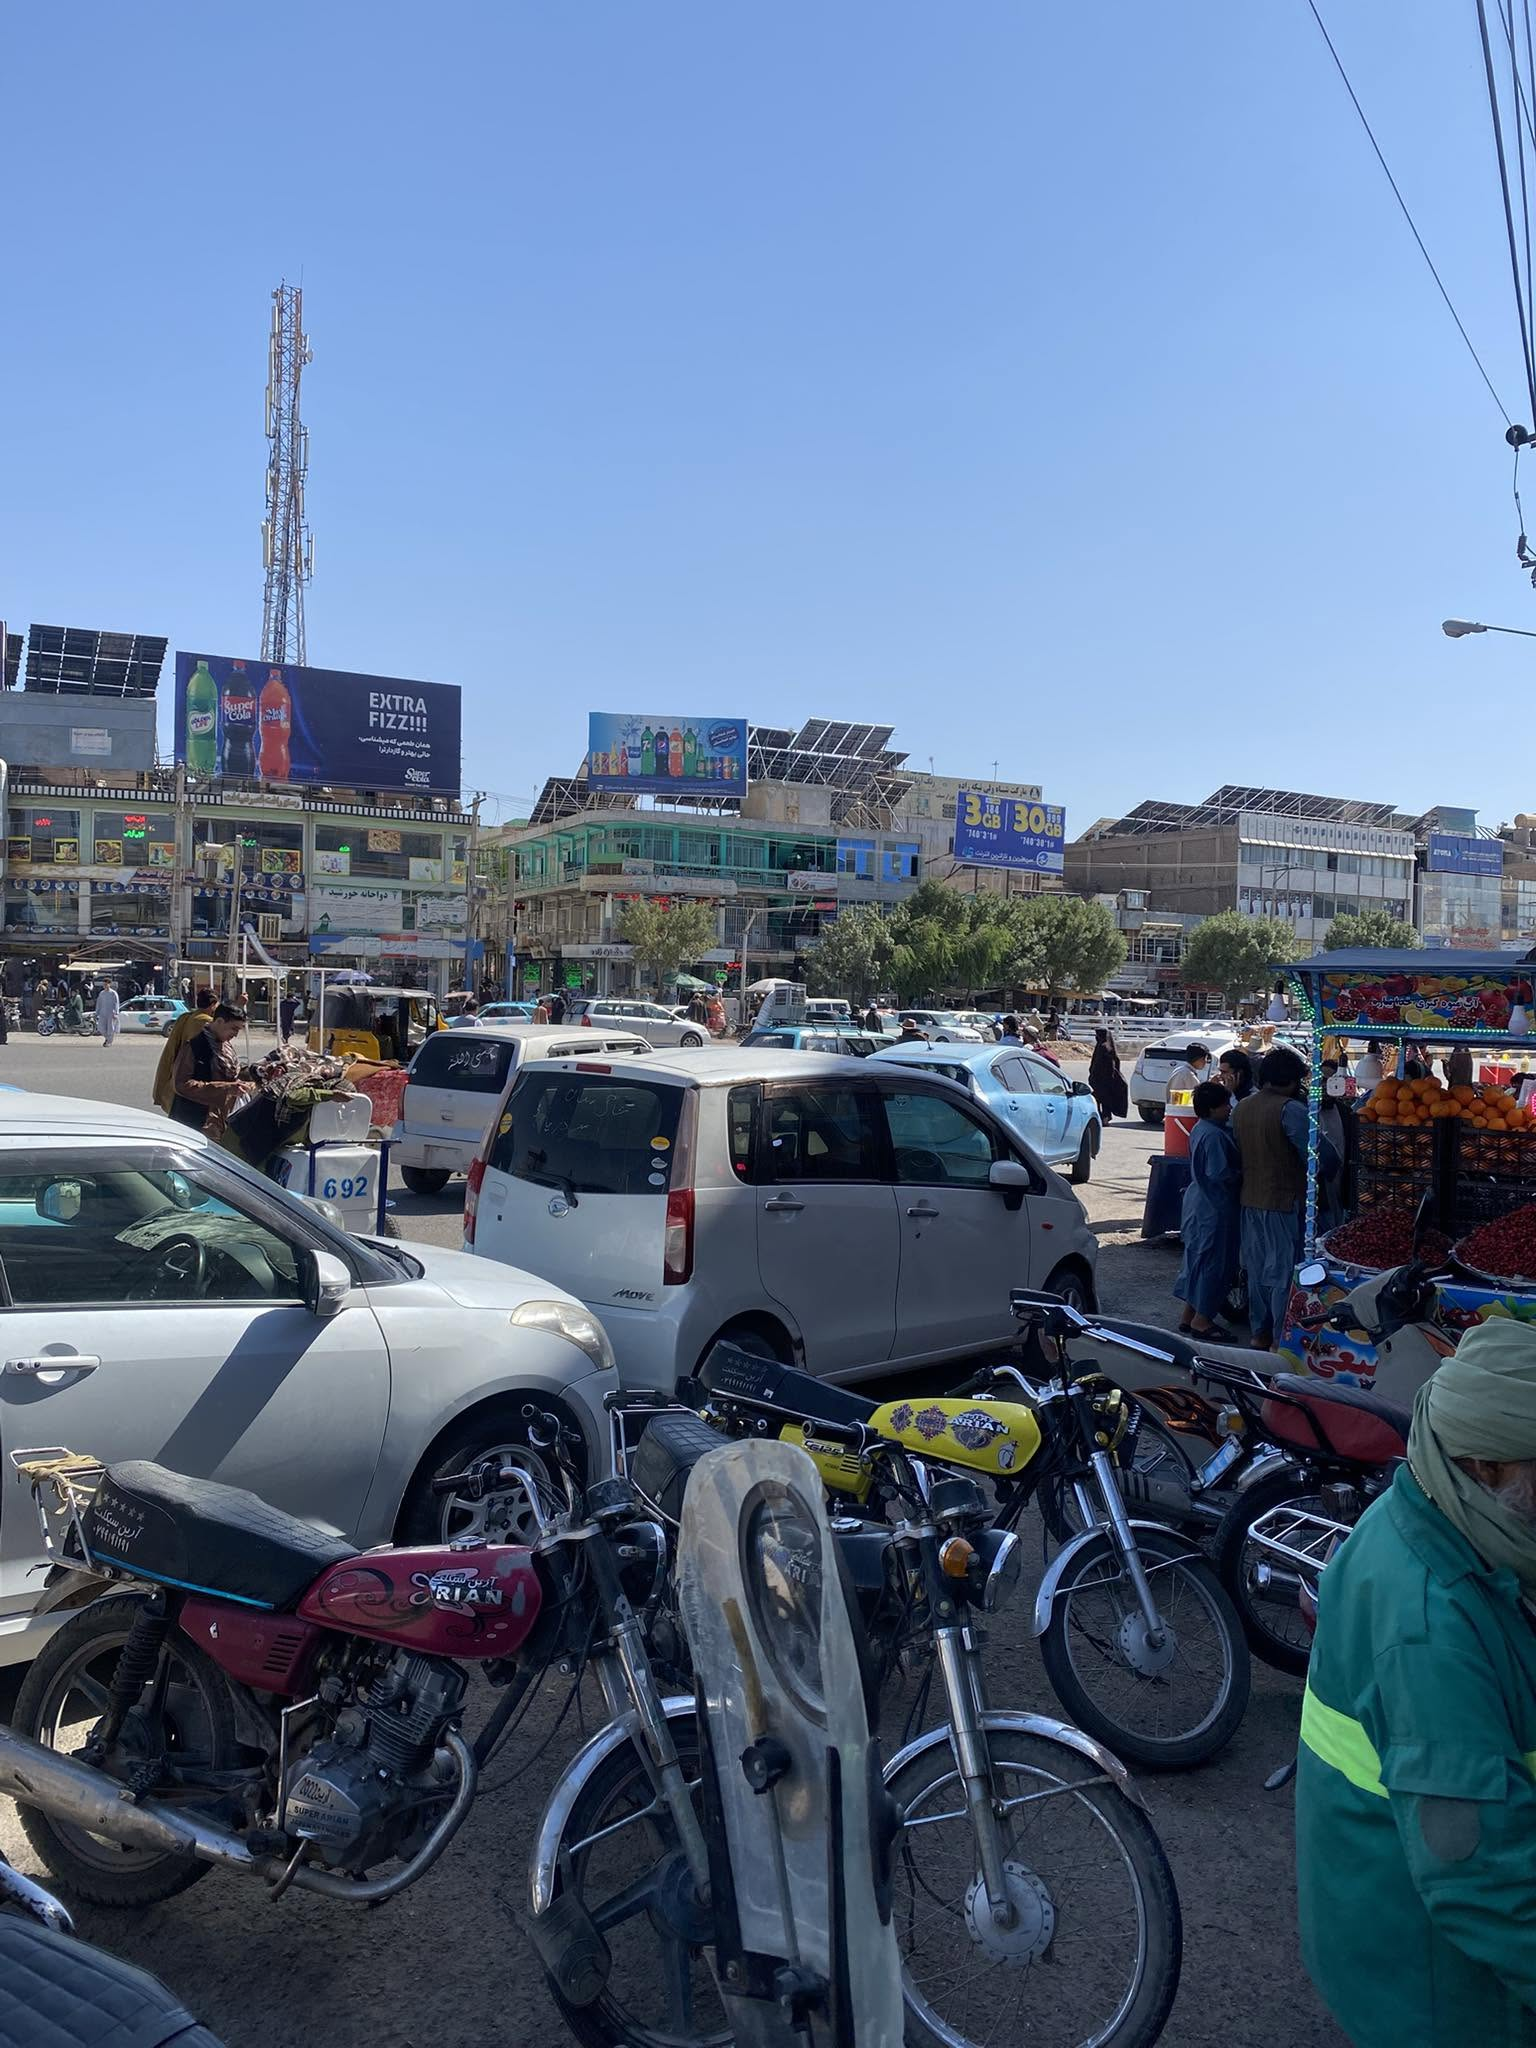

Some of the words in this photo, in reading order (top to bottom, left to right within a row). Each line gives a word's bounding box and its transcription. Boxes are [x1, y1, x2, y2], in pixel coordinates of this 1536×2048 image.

[224, 700, 254, 715] Super
[369, 692, 428, 714] EXTRA
[229, 710, 252, 721] Cola
[369, 711, 427, 733] FIZZ!!!
[964, 795, 982, 826] 3
[982, 813, 1001, 829] GB
[1013, 803, 1046, 835] 30
[1045, 822, 1063, 838] GB
[323, 1175, 368, 1200] 692
[612, 1288, 655, 1302] MOVE
[946, 1417, 1010, 1435] ARIAN
[804, 1439, 844, 1456] CG125
[117, 1524, 145, 1539] آرین
[294, 1805, 320, 1819] SUPER
